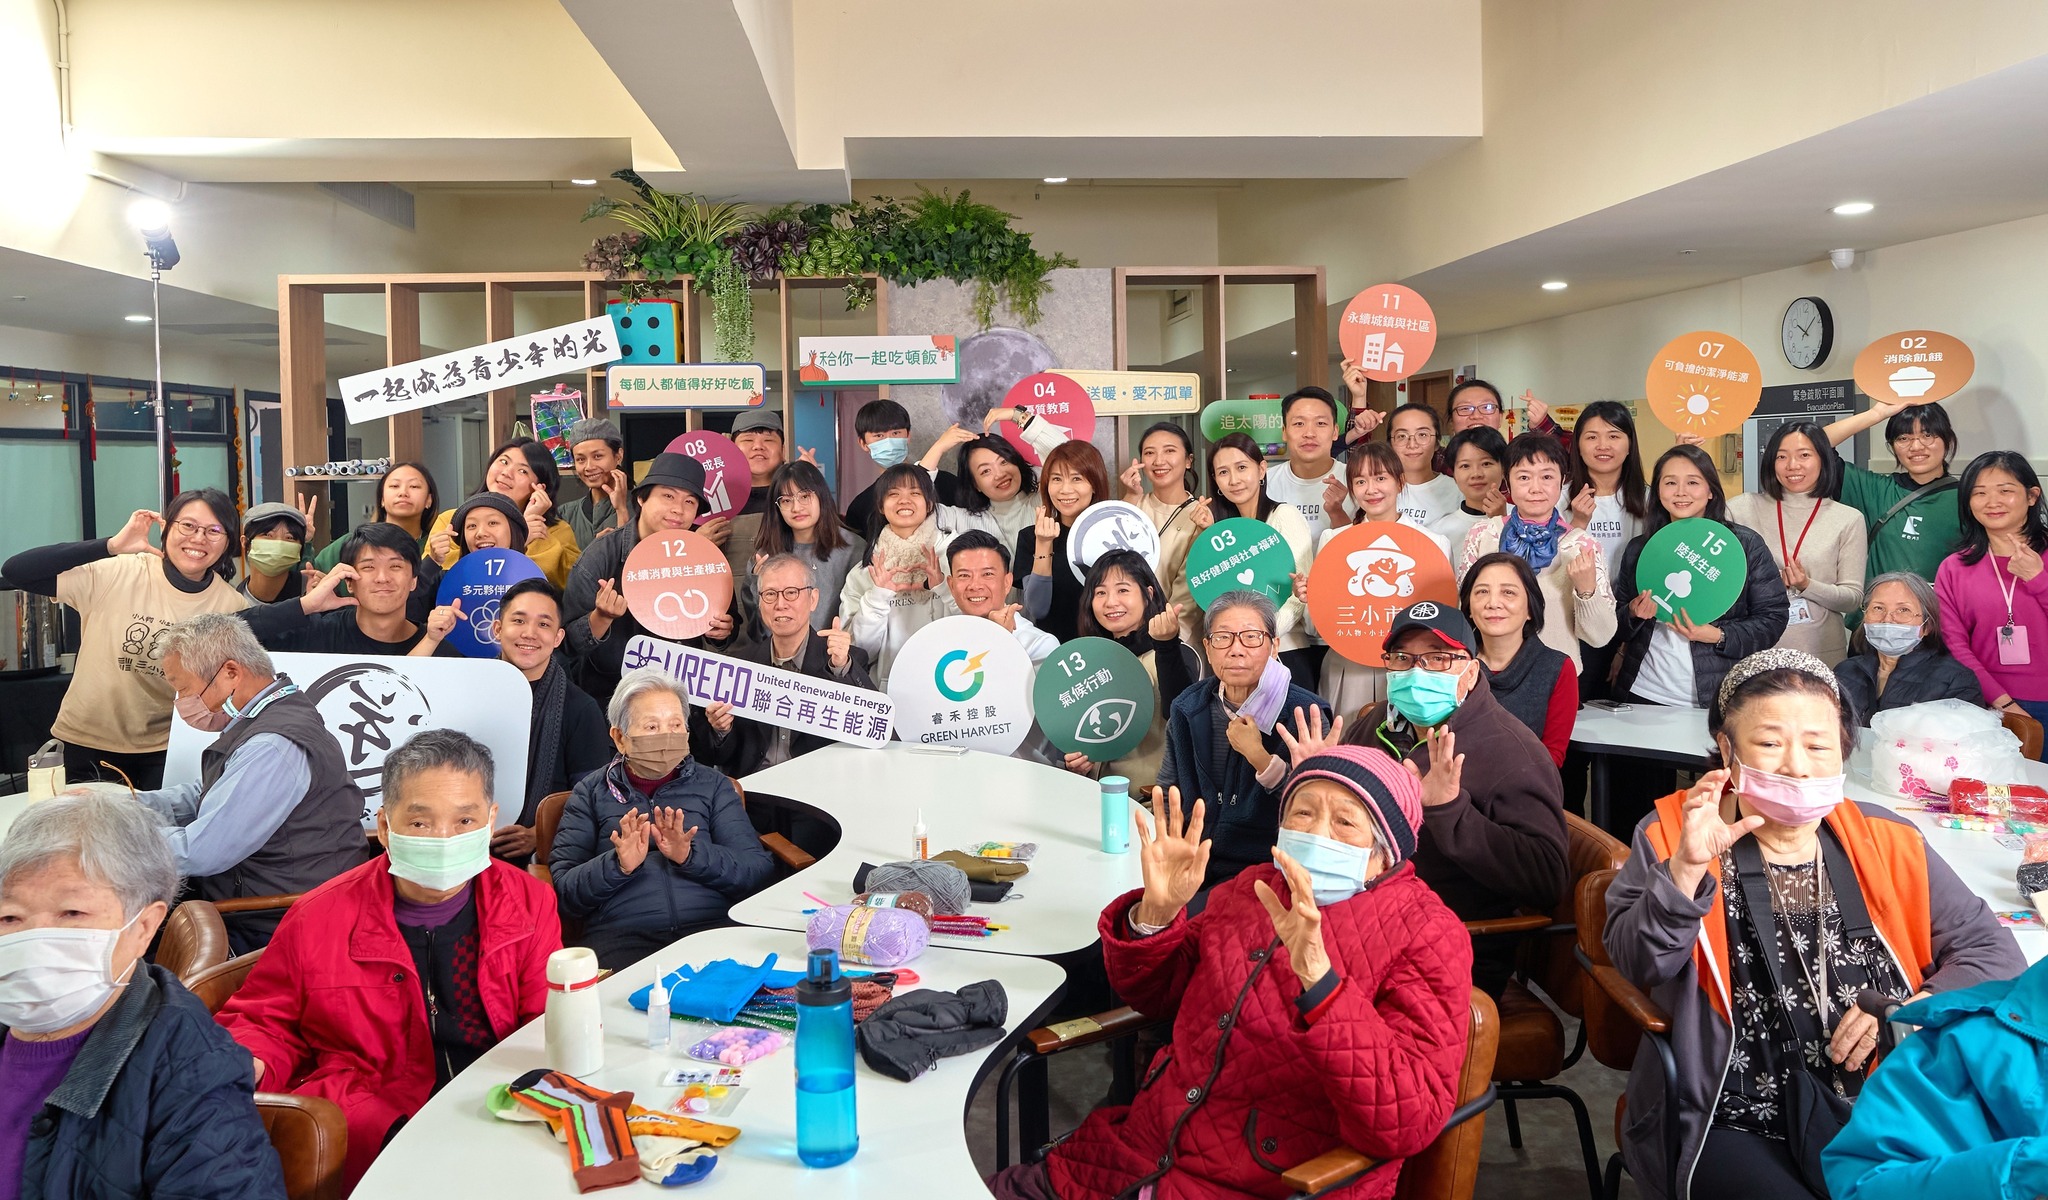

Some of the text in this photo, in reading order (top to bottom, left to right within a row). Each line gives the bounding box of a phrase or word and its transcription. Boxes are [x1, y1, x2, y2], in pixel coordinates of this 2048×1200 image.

[1381, 293, 1401, 310] 11
[1347, 311, 1431, 333] 永續城鎮與社區
[1698, 341, 1725, 359] 07
[1900, 336, 1928, 350] 02
[354, 328, 608, 403] 一起成為青少年的光
[1883, 351, 1944, 364] 消除飢餓
[1664, 359, 1750, 384] 可負擔的潔淨能源
[619, 377, 755, 391] 每個人都值得好好吃飯
[1033, 381, 1056, 398] 04
[684, 439, 707, 458] 08
[1590, 521, 1621, 531] URECO
[661, 539, 688, 558] 12
[1210, 529, 1237, 552] 03
[1701, 531, 1728, 556] 15
[484, 558, 506, 576] 17
[1190, 532, 1281, 589] 良好健康與社會福利
[1673, 541, 1722, 583] 陸域生態
[626, 562, 728, 582] 永續消費與生產模式
[1057, 651, 1087, 677] 13
[756, 672, 893, 715] United Renewable Energy
[1058, 667, 1114, 708] 氣候行動
[751, 688, 889, 741] 聯合再生能源
[931, 705, 997, 725] 睿禾控股
[920, 722, 1012, 744] GREEN HARVEST
